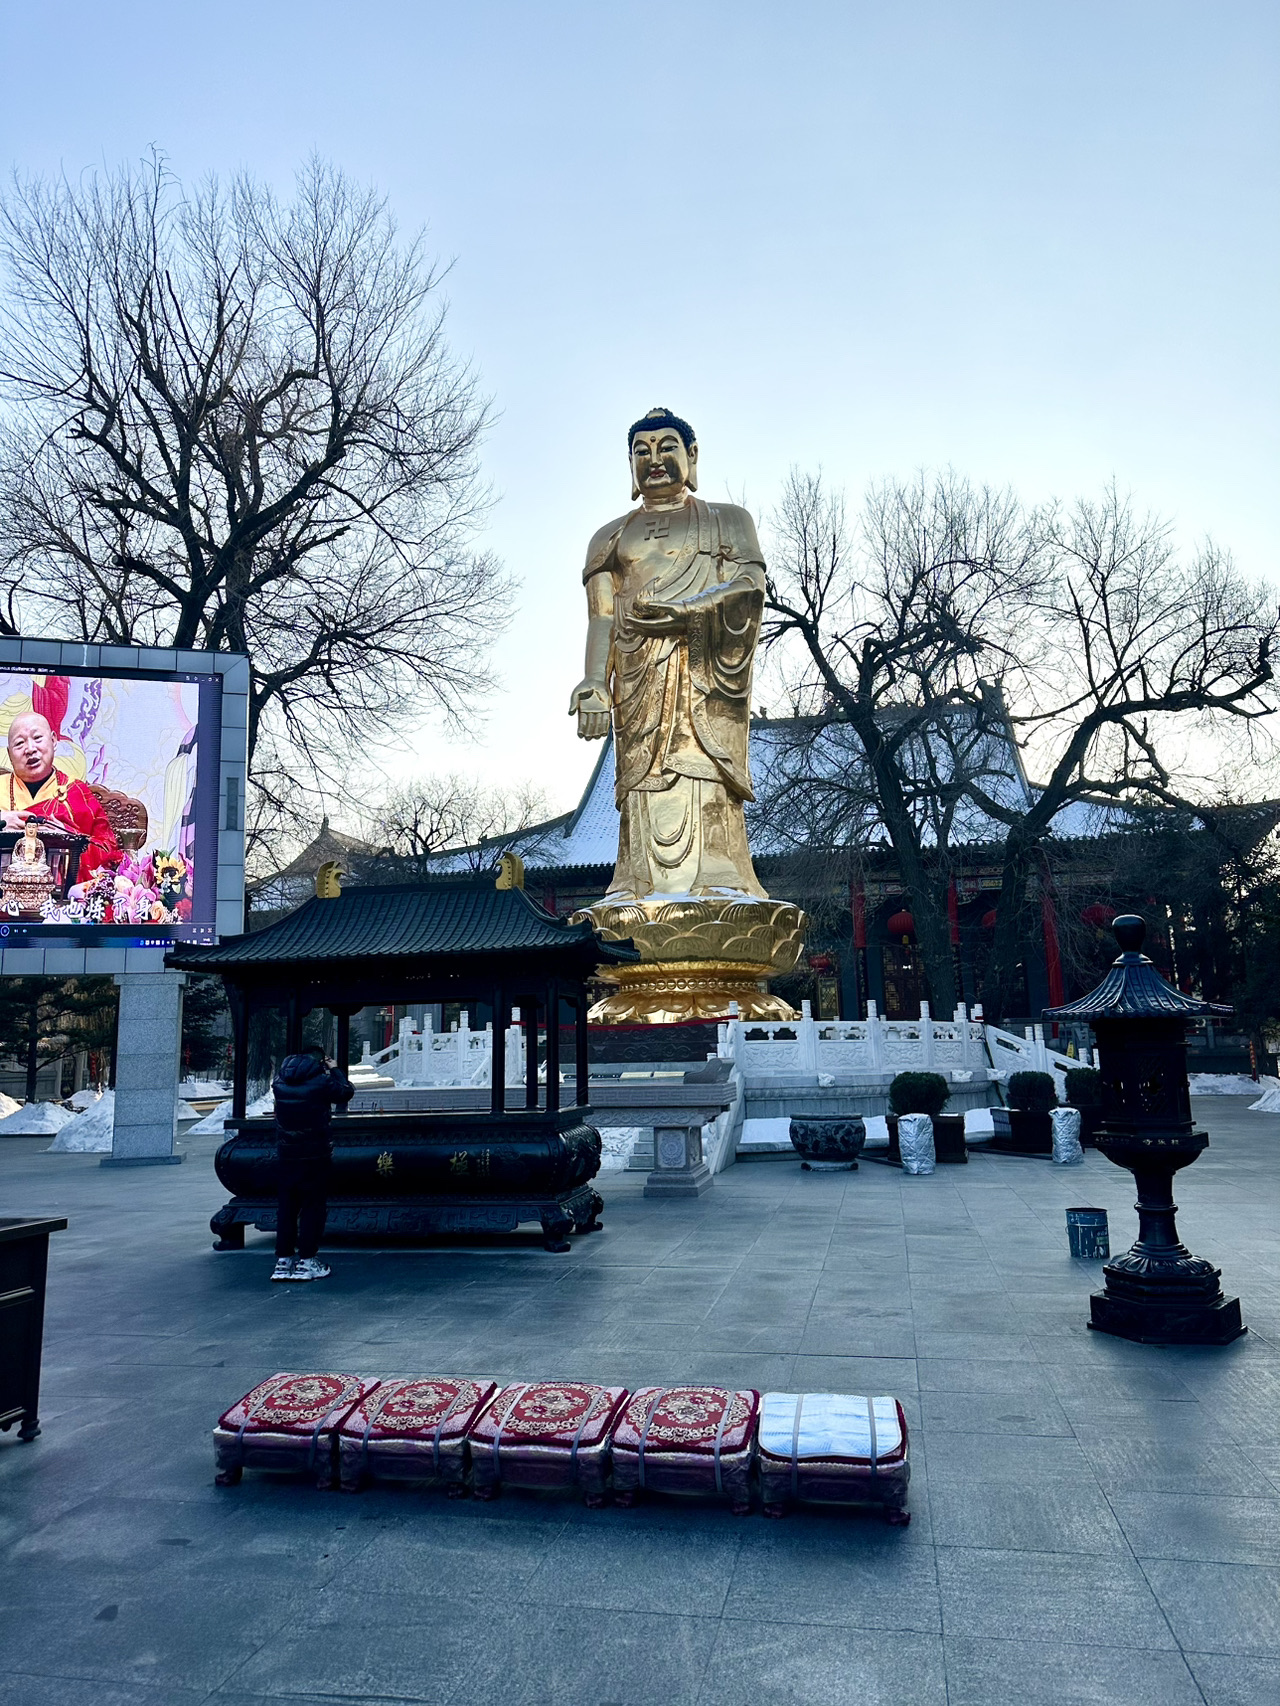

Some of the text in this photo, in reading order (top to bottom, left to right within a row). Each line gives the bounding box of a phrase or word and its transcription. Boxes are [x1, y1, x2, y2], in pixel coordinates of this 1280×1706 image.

[1, 894, 152, 922] 心 我也炼了身
